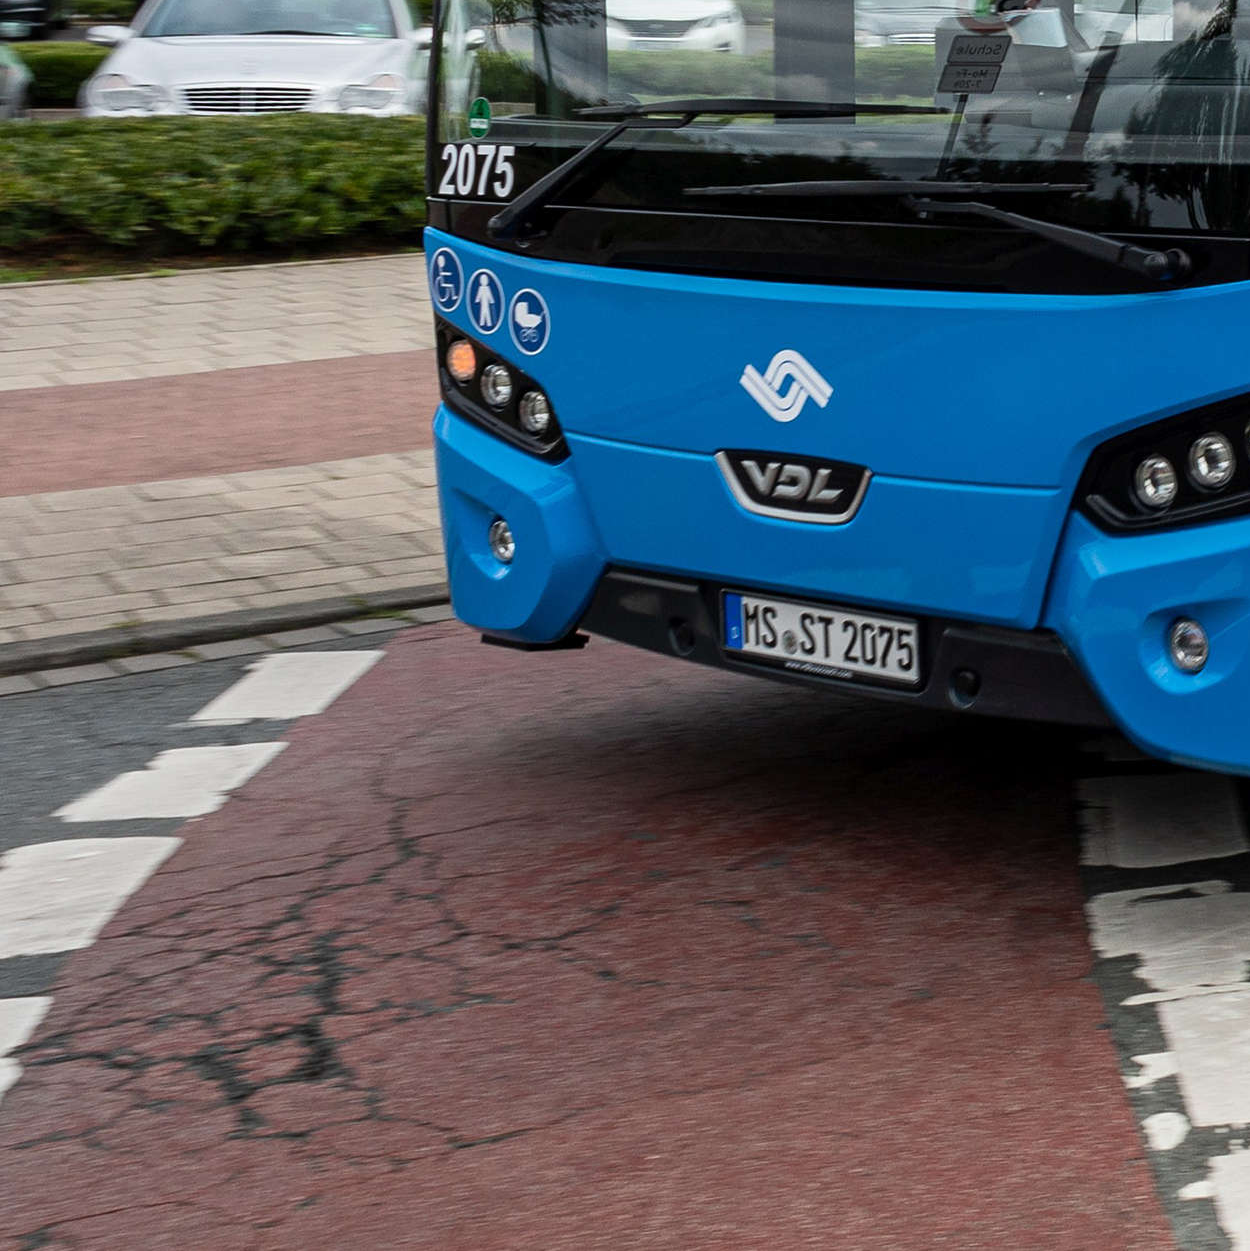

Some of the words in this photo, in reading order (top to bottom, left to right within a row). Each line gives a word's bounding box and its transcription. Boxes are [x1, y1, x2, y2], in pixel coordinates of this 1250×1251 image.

[438, 143, 515, 197] 2075
[740, 459, 844, 502] VDL
[742, 602, 778, 650] MS
[799, 613, 834, 659] ST
[841, 619, 914, 672] 2075
